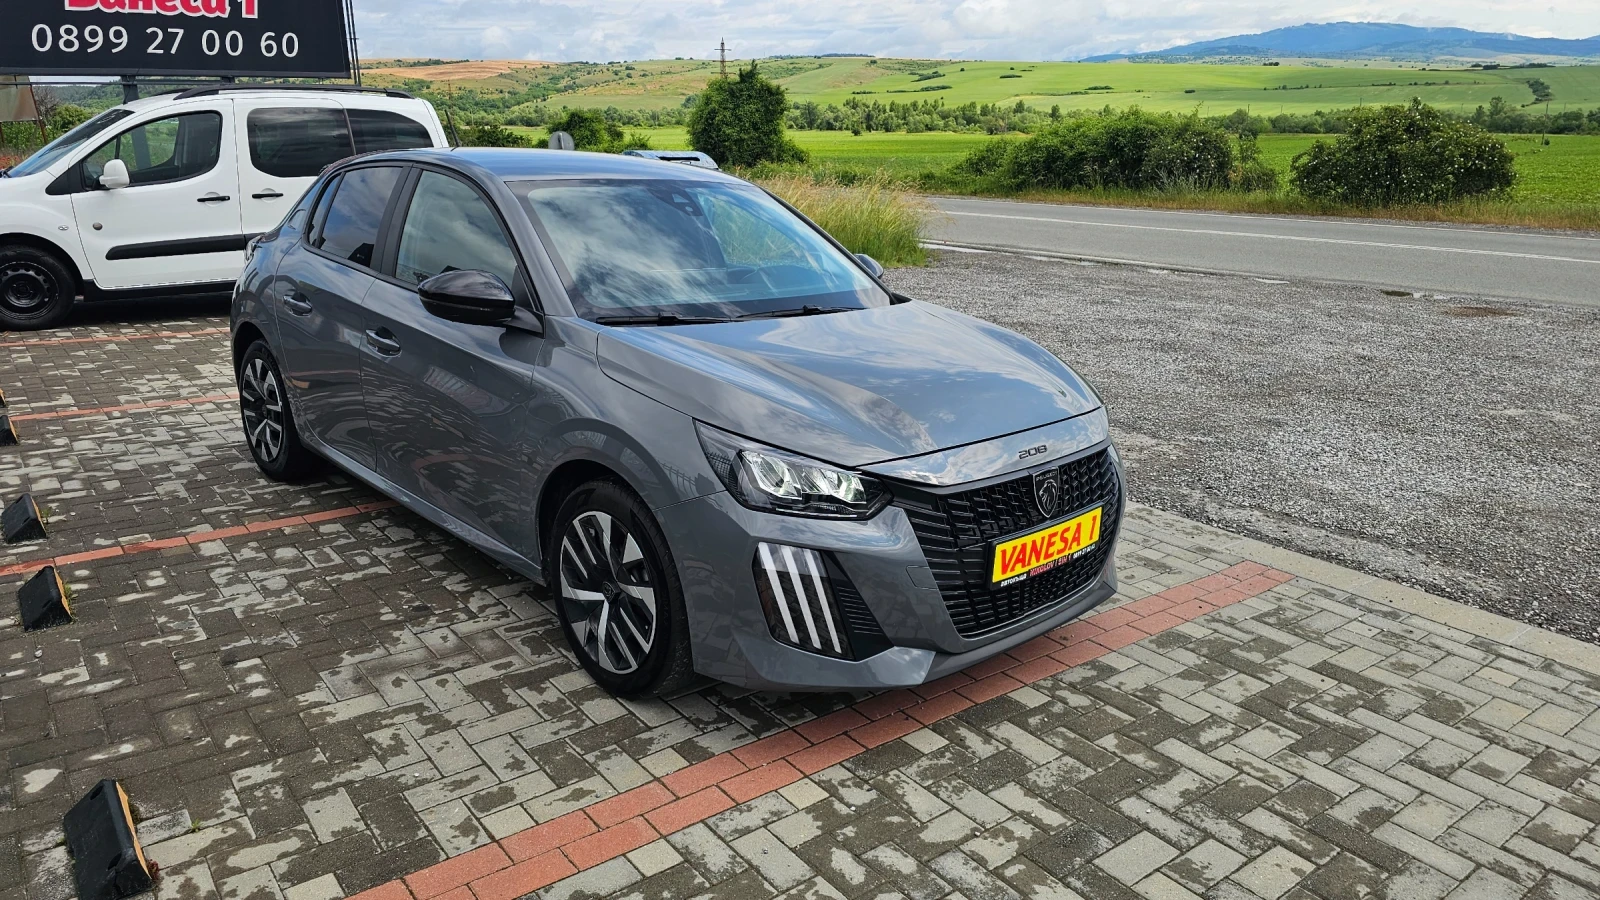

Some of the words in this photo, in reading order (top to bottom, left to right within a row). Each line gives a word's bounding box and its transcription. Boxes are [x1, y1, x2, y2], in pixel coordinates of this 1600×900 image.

[31, 24, 129, 53] 0899
[146, 27, 184, 54] 27
[201, 29, 243, 56] 00
[260, 32, 299, 58] 60
[1018, 444, 1047, 460] 208
[1001, 522, 1081, 575] VANESA
